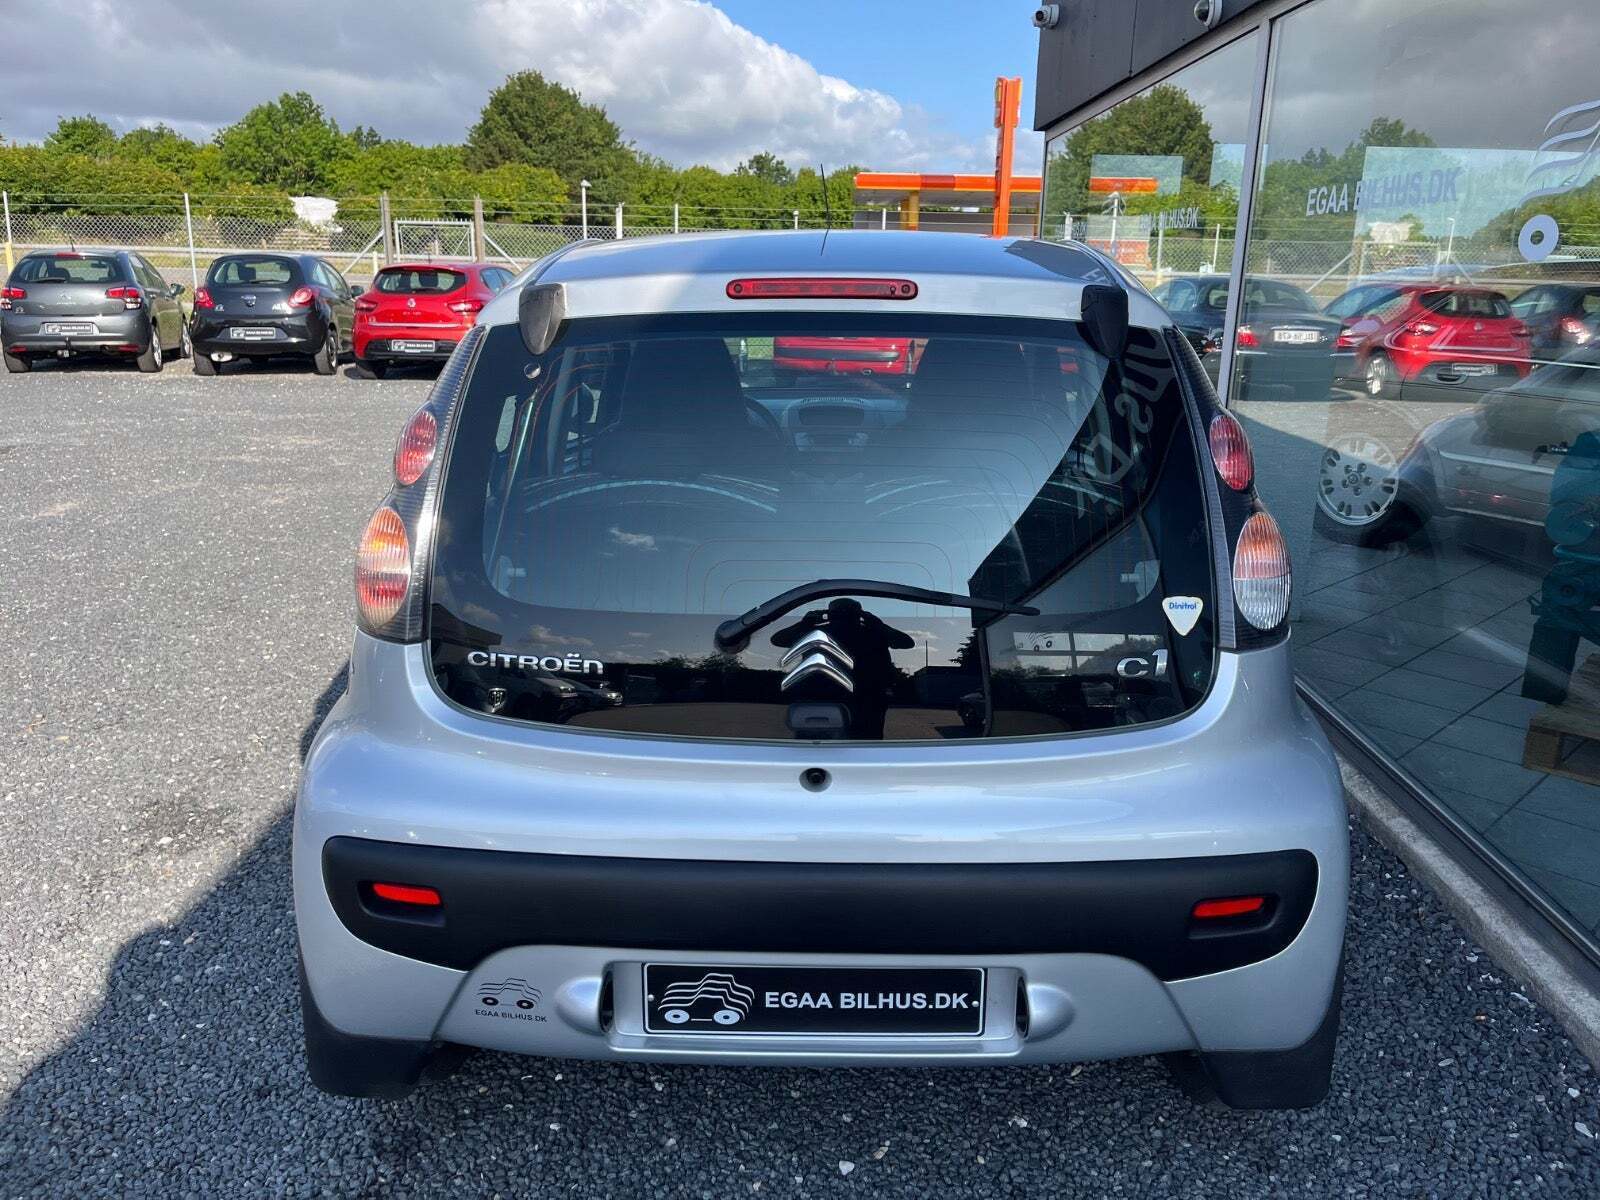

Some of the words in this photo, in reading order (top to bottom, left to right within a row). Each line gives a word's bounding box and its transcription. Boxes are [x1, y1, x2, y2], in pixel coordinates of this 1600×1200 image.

[1306, 183, 1348, 217] EGAA
[1169, 601, 1197, 610] Dinitrol
[764, 991, 833, 1009] EGAA
[840, 992, 969, 1009] BILHUS.DK
[475, 1009, 500, 1018] EGAA
